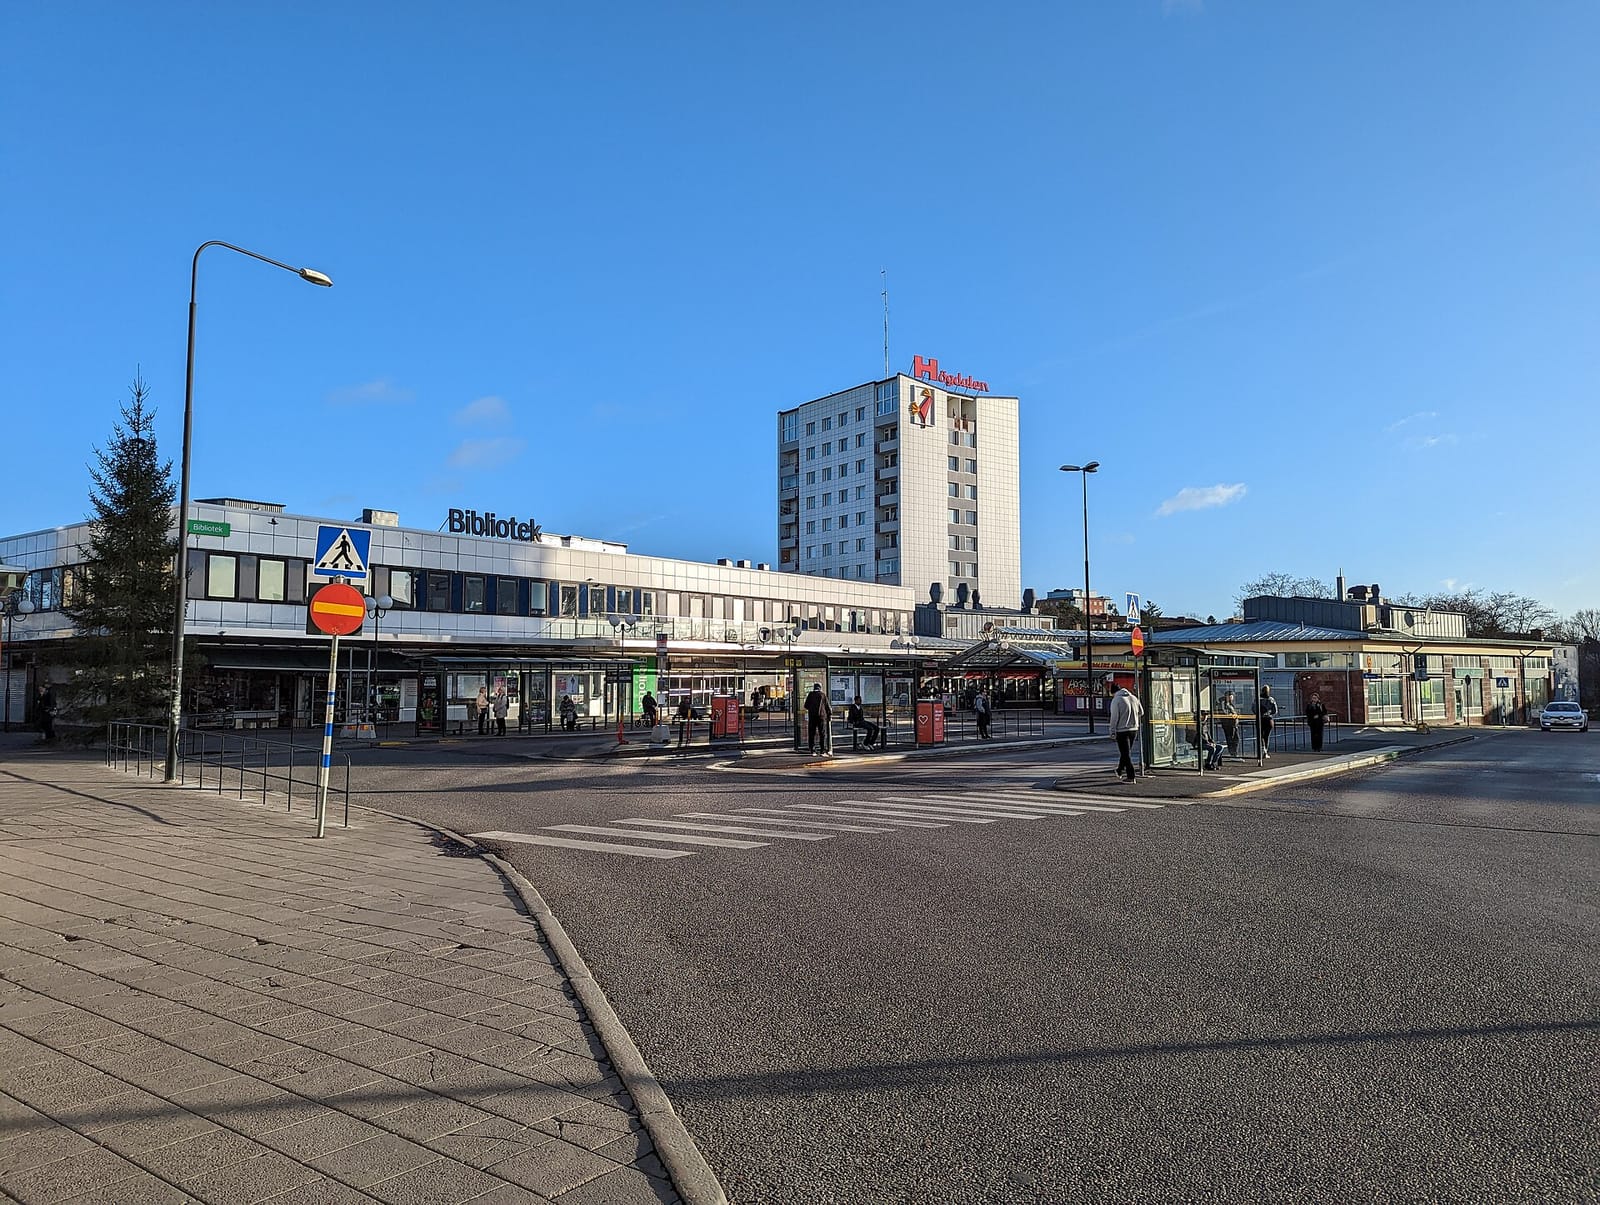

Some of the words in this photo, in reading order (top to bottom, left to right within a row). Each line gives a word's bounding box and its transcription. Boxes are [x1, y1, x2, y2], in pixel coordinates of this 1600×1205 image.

[914, 355, 989, 392] Högdalen
[193, 523, 223, 533] Bibliotek
[449, 508, 542, 542] Bibliotek
